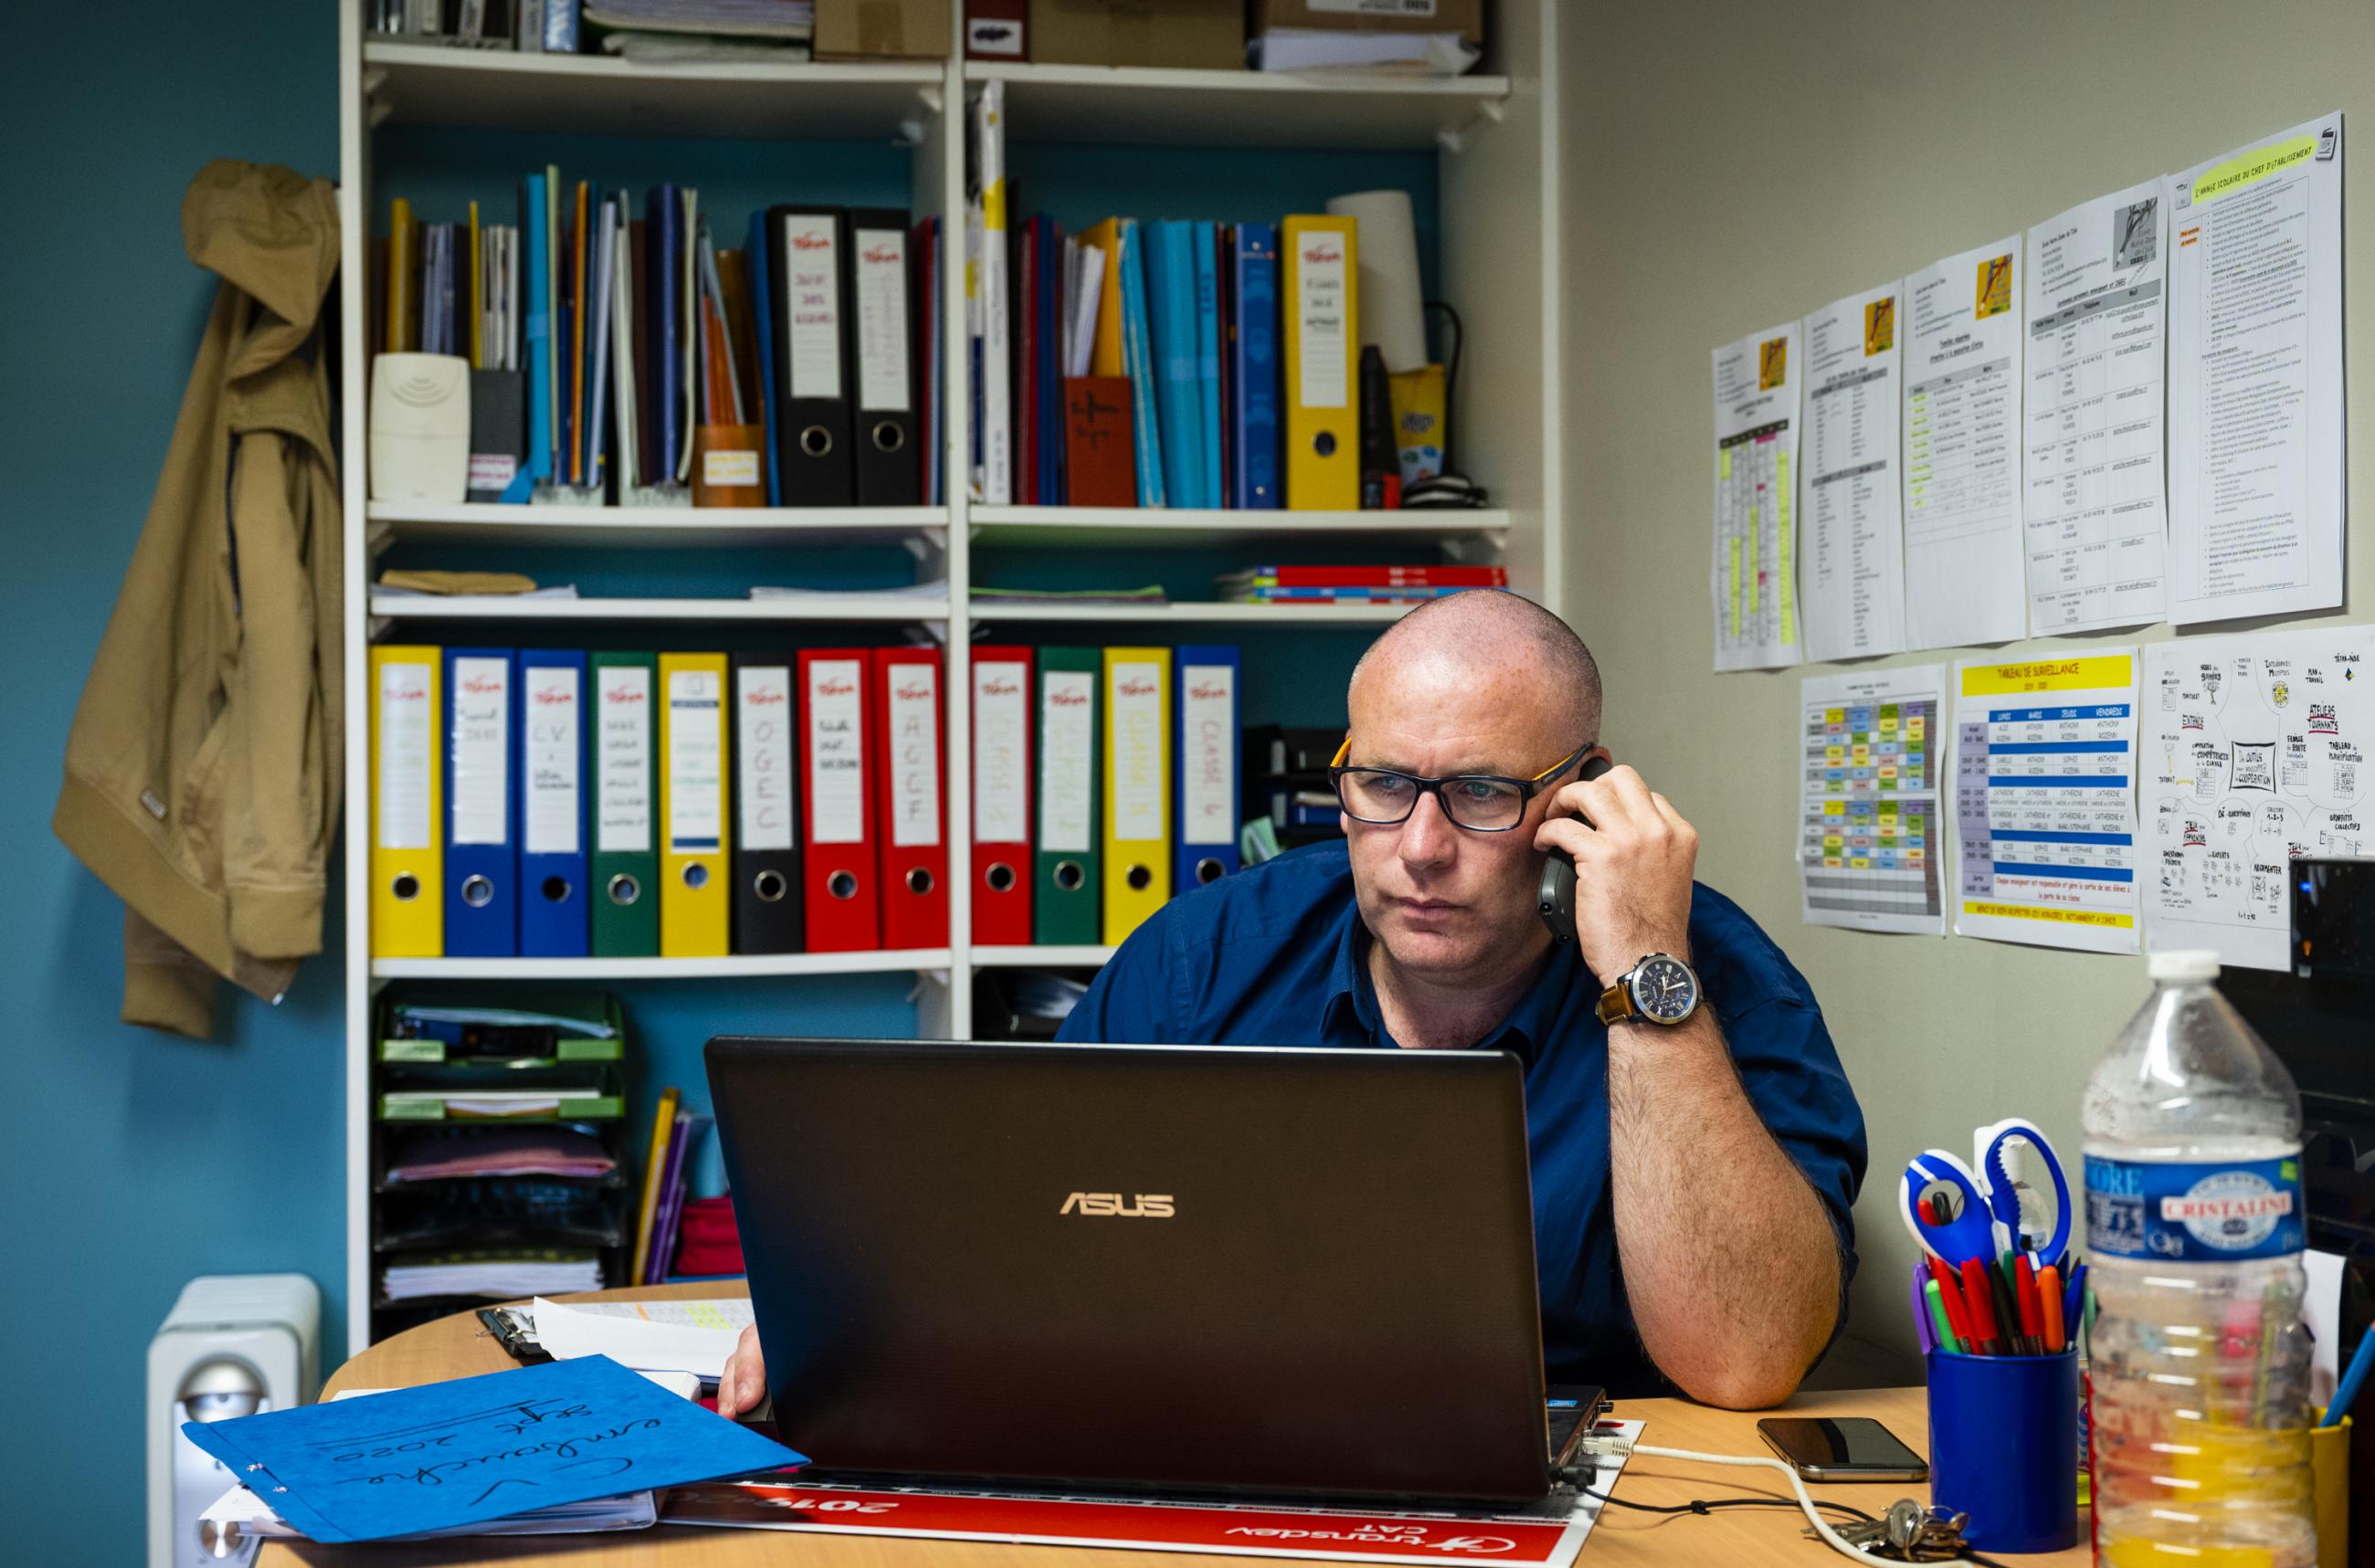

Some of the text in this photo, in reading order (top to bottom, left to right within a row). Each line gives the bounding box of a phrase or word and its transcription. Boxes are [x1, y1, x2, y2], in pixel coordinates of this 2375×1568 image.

[2217, 174, 2241, 188] SCOLAIRE
[2243, 171, 2250, 180] DU
[2251, 163, 2264, 176] CHEF
[1997, 663, 2079, 679] TABLEAU DE SURVEILLANCE
[2095, 707, 2123, 716] VENDREDI
[2310, 700, 2336, 718] ATELIERS
[2306, 719, 2338, 731] TOURNANTS
[2328, 742, 2351, 751] TABLEAU
[2335, 823, 2360, 831] COLLECTIFS
[1060, 1192, 1176, 1217] ASUS
[333, 1404, 592, 1462] sept 2020
[332, 1418, 661, 1486] embauche
[1225, 1527, 1425, 1545] transdev
[1355, 1524, 1428, 1535] CAT
